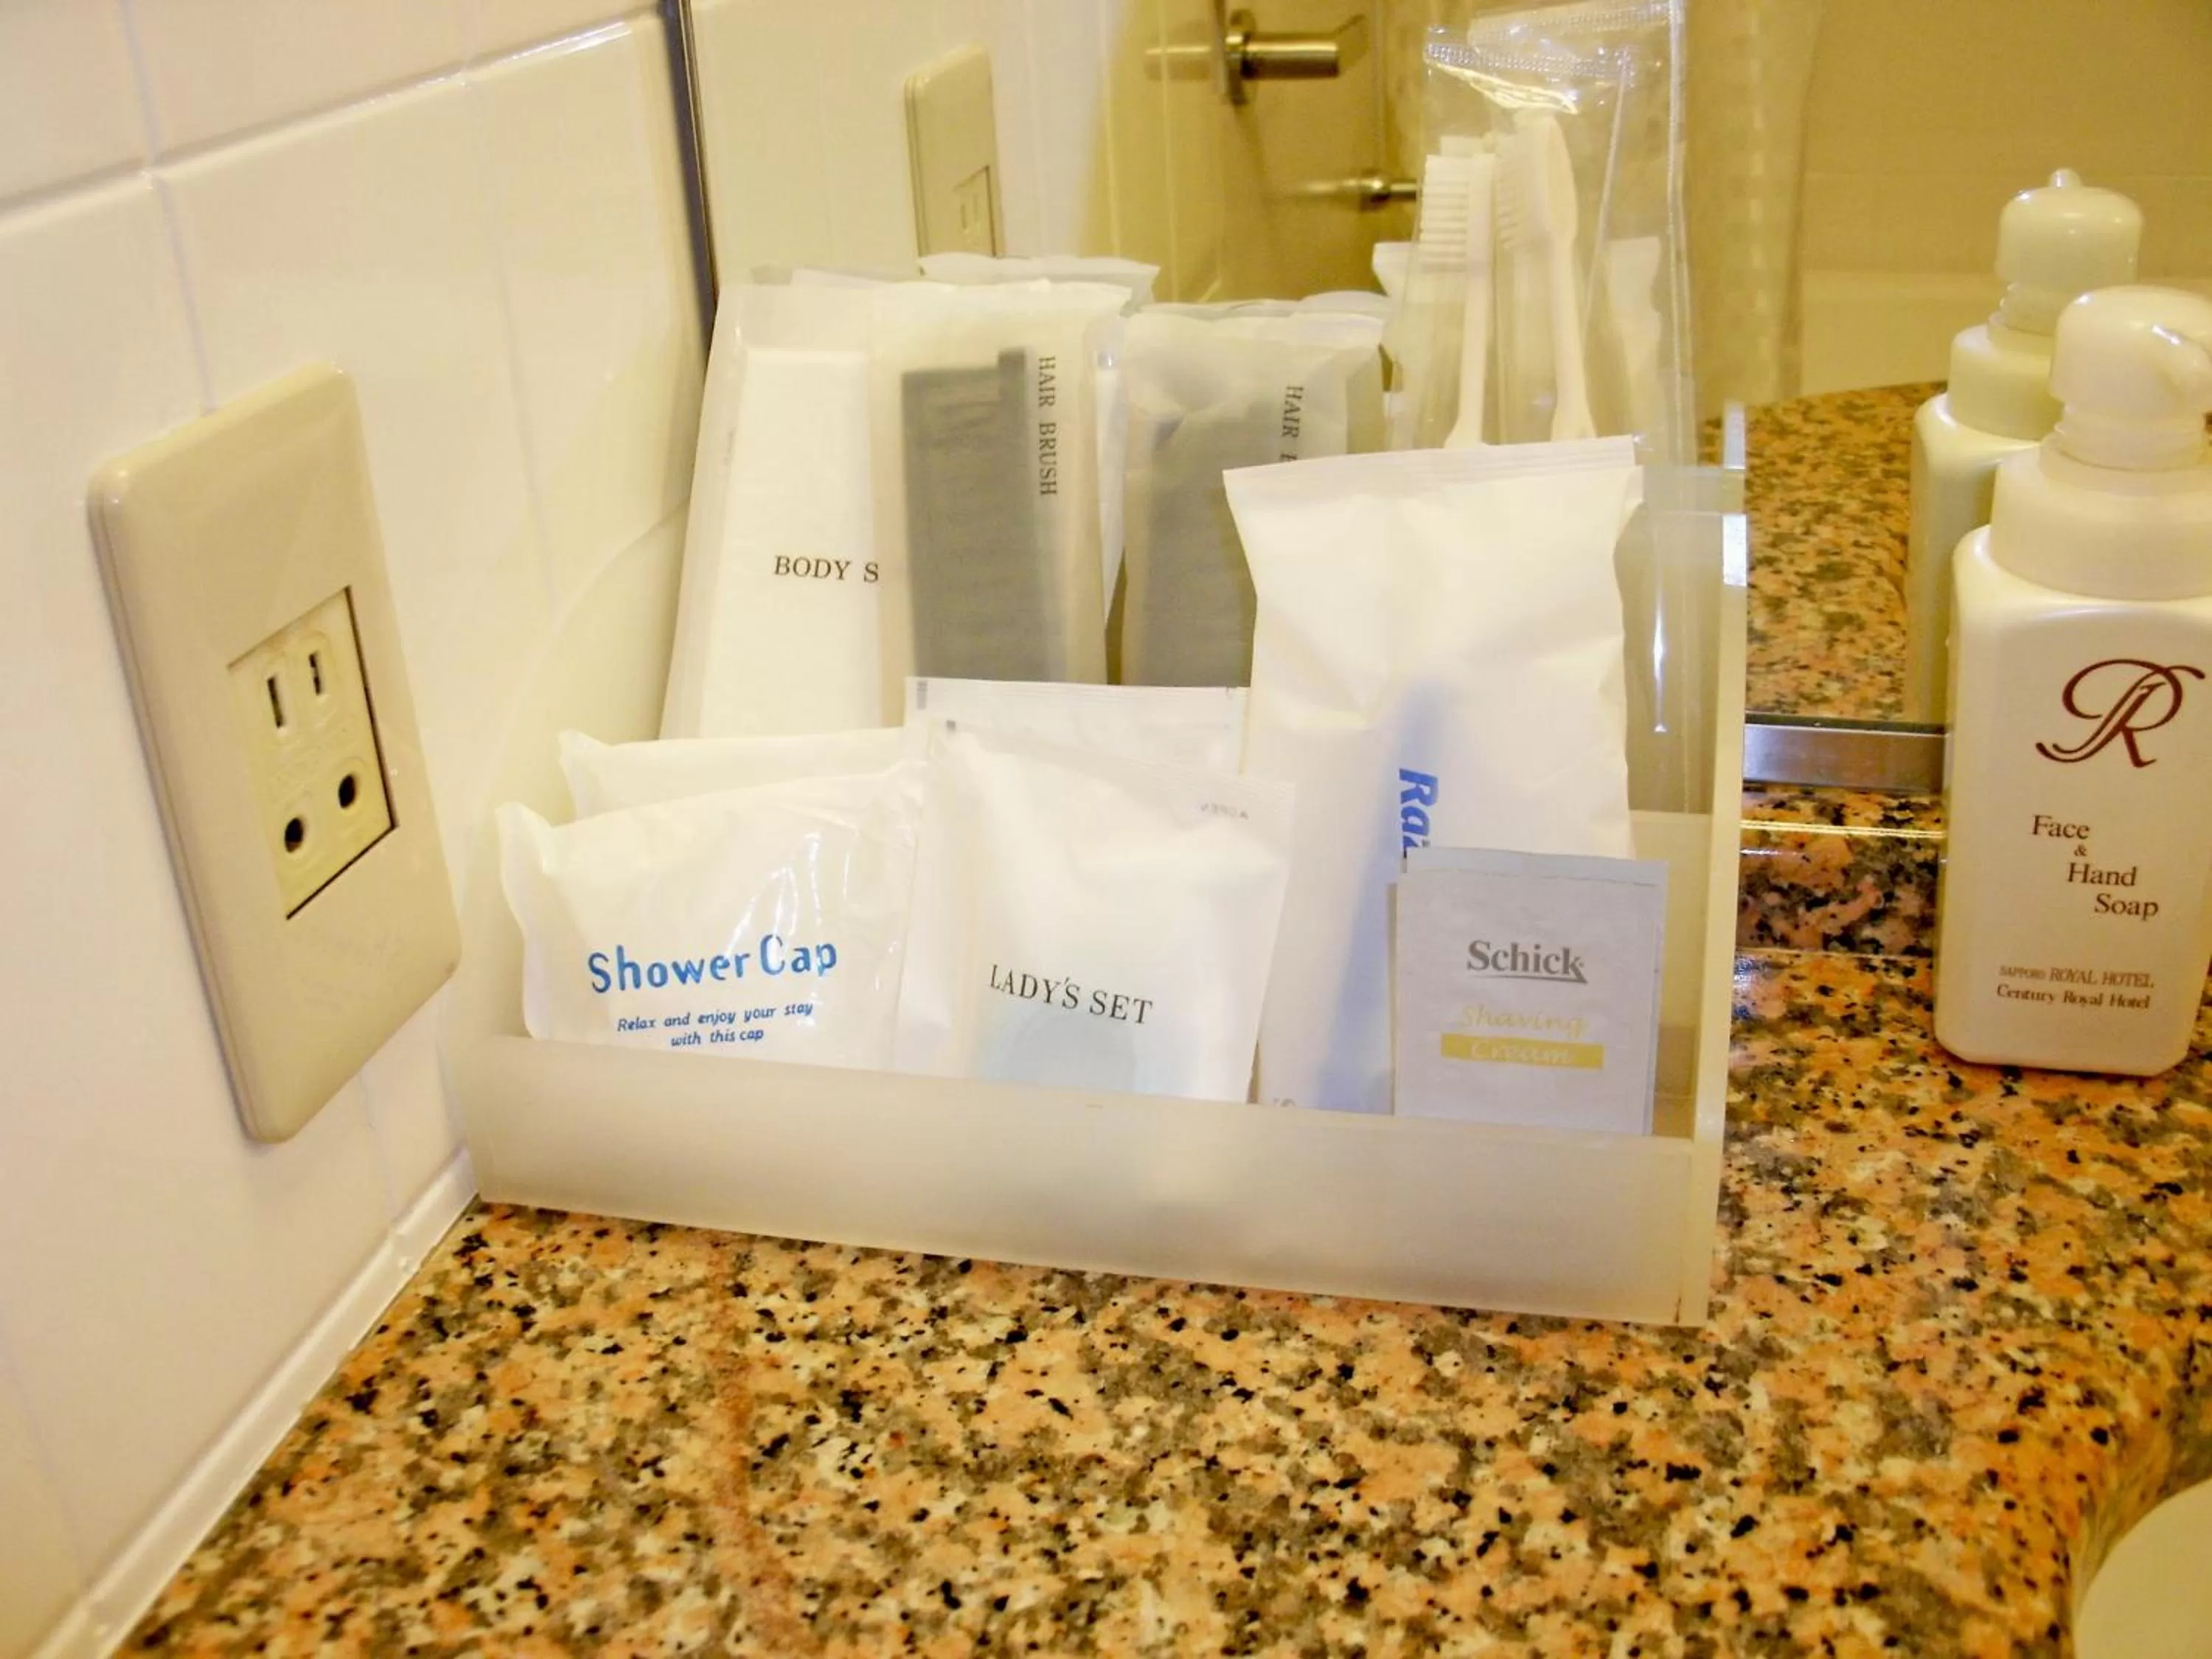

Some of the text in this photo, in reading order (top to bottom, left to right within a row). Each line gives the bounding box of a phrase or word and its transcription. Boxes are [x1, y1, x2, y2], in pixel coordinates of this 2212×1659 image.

[1038, 355, 1058, 495] HAIR BRUSH
[1281, 386, 1304, 437] HAIR
[773, 554, 852, 581] BODY
[2031, 814, 2090, 840] Face
[2073, 844, 2088, 858] &
[2066, 862, 2138, 887] Hand
[2093, 892, 2159, 921] Soap
[588, 933, 838, 994] Shower Cap
[1466, 939, 1588, 984] Schick
[2049, 967, 2098, 985] ROYAL
[2101, 970, 2154, 989] HOTEL
[990, 963, 1153, 1025] LADY'S SET
[1996, 982, 2151, 1009] Century Royal Hotel
[616, 1002, 814, 1032] Relax and enjoy your stay
[1461, 1003, 1589, 1038] Shaving
[671, 1028, 765, 1047] with this cap
